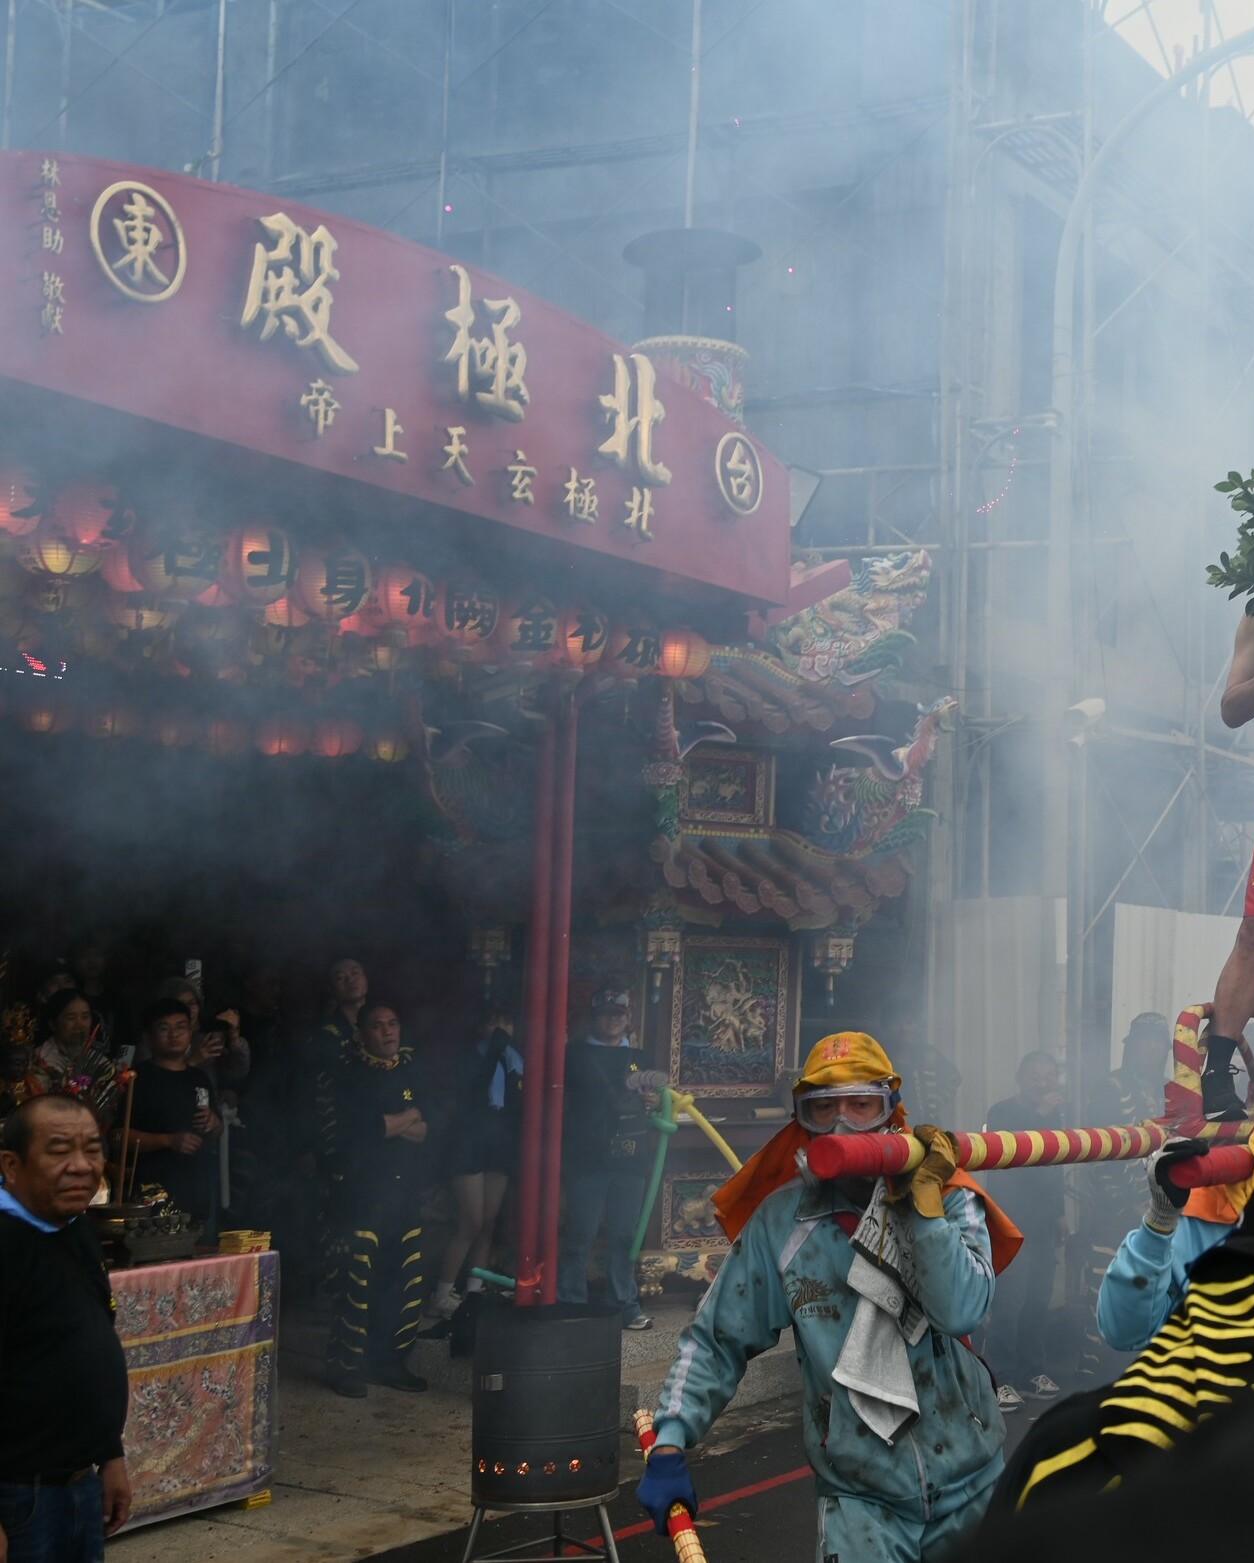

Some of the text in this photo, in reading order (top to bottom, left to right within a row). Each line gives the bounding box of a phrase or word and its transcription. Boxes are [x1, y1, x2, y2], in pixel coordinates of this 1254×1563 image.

[112, 192, 171, 284] 東
[240, 211, 673, 487] 北極殿
[726, 440, 756, 501] 台
